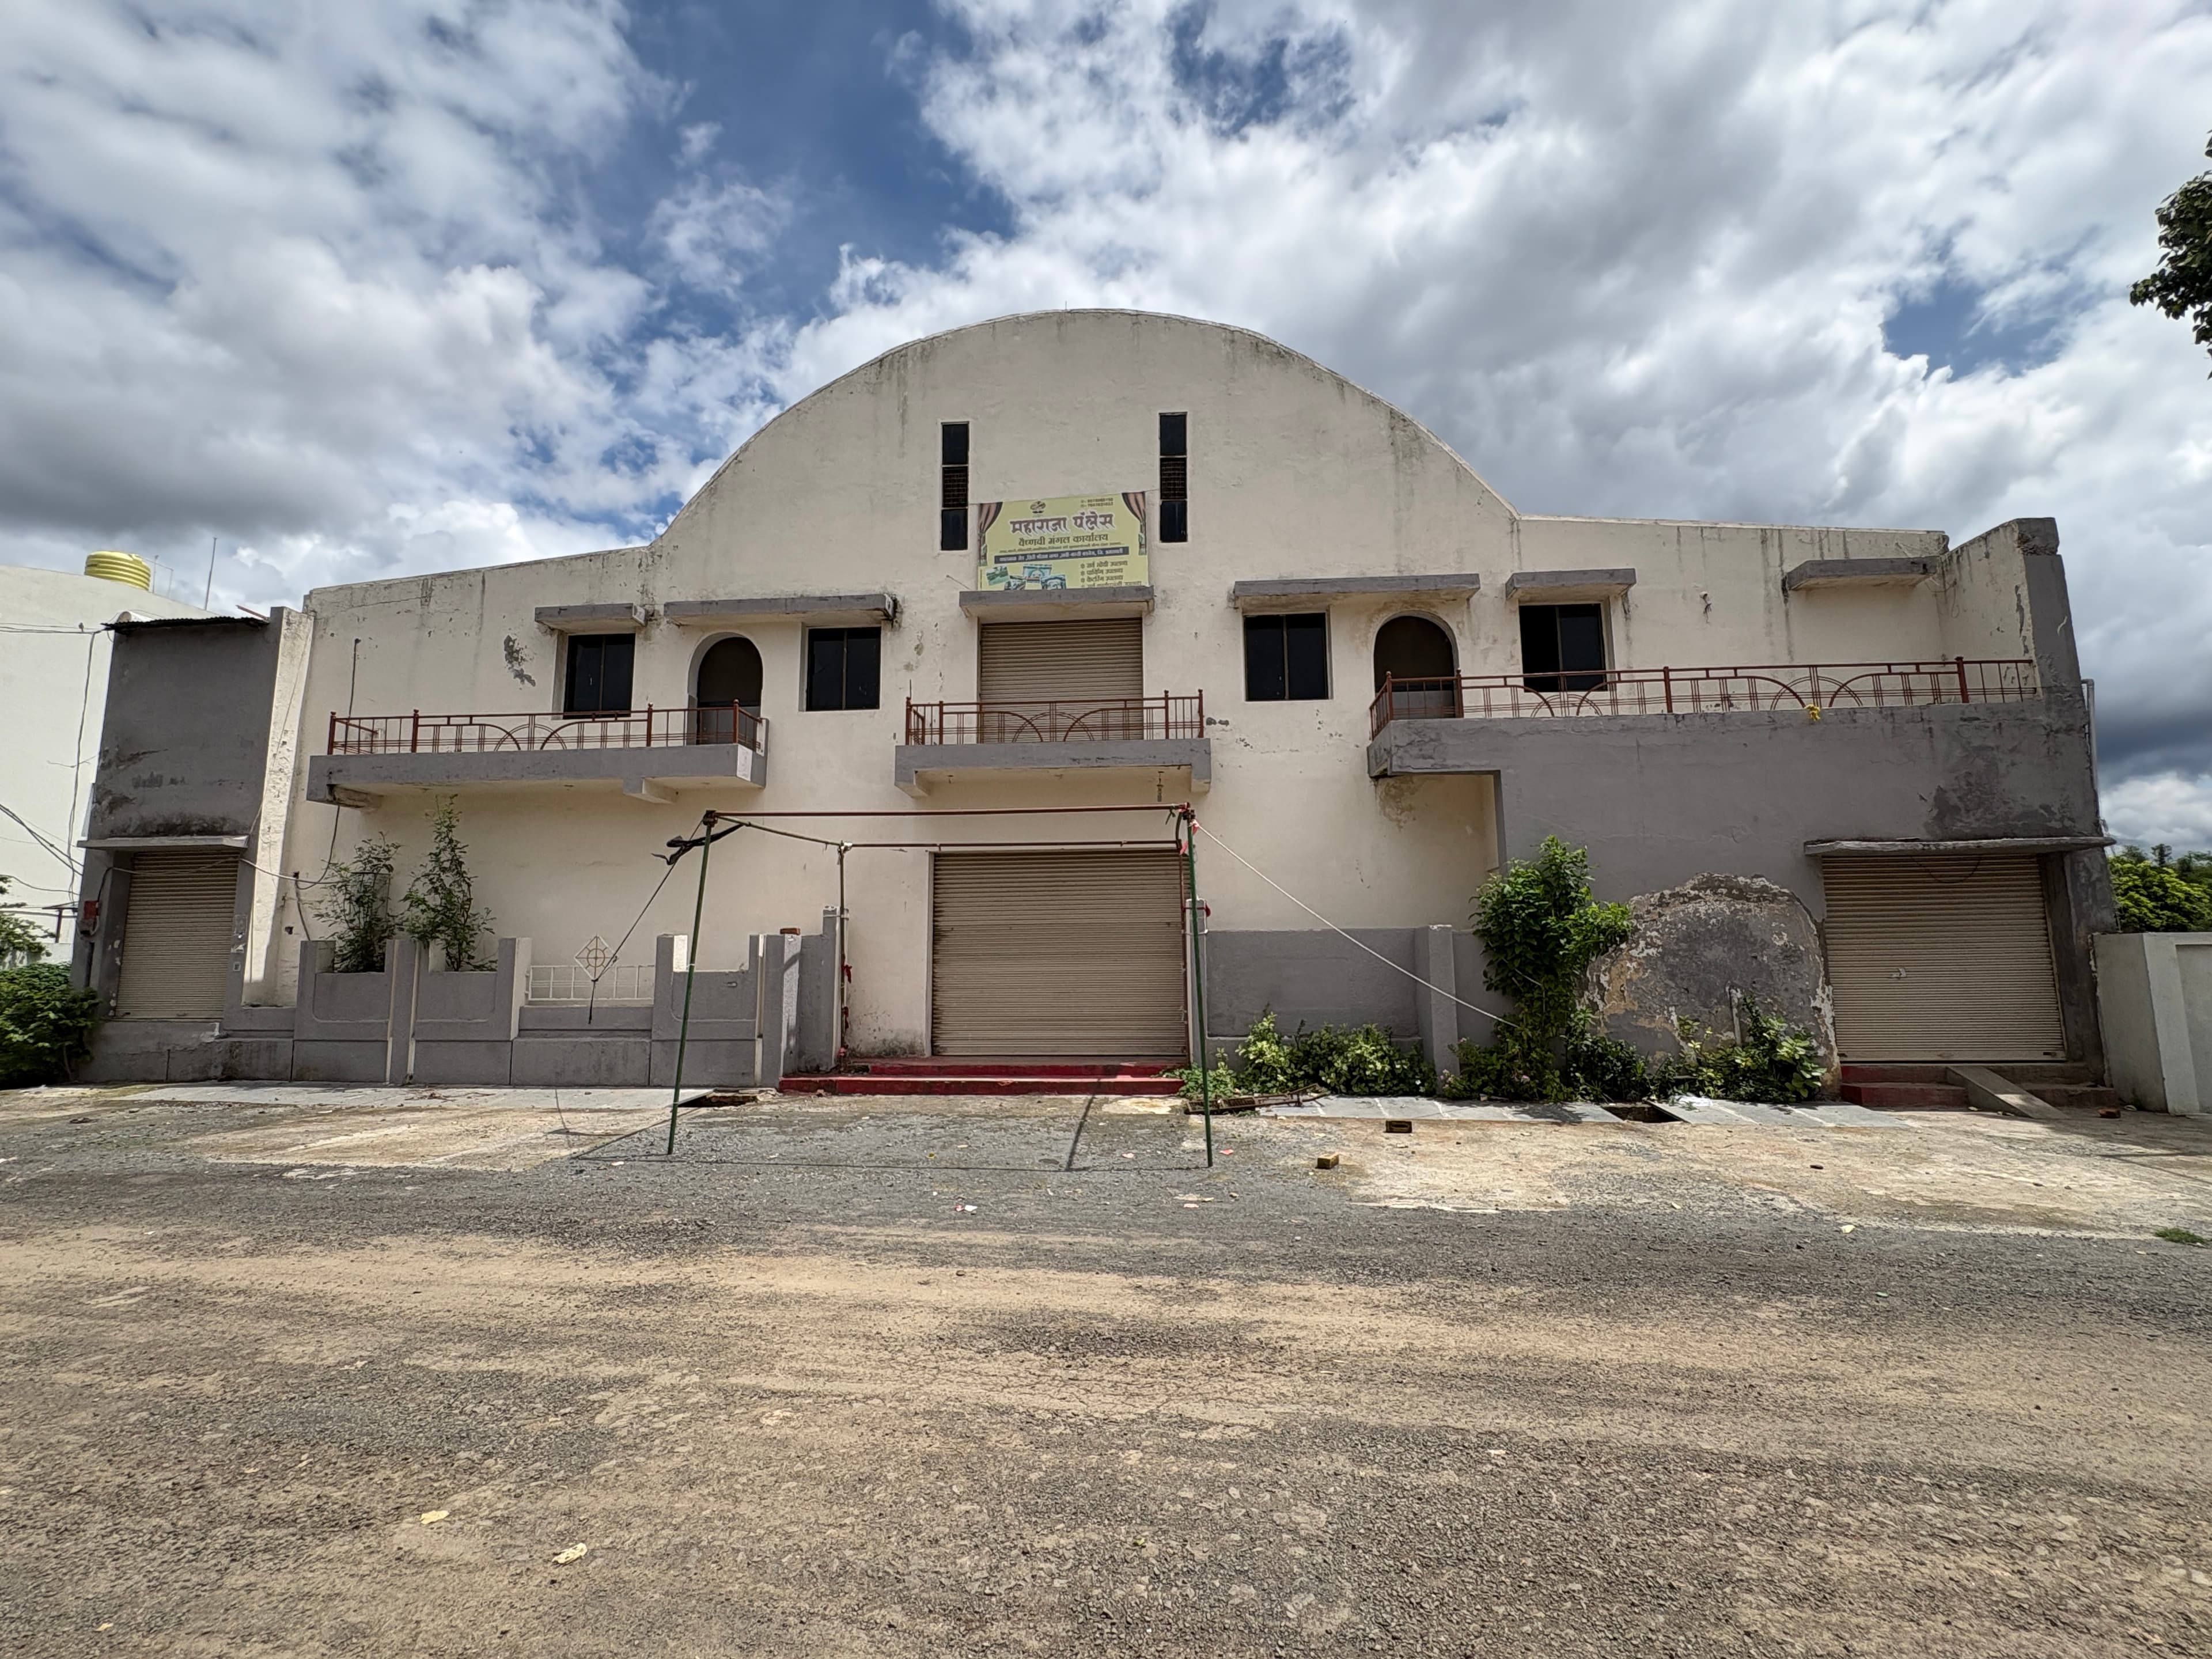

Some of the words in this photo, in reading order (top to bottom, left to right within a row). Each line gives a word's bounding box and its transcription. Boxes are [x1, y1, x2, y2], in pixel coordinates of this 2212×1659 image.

[1009, 517, 1070, 536] महाराजा
[1018, 536, 1046, 546] वैष्णवी
[1048, 535, 1070, 544] मंगल
[1073, 532, 1108, 543] कार्यालय
